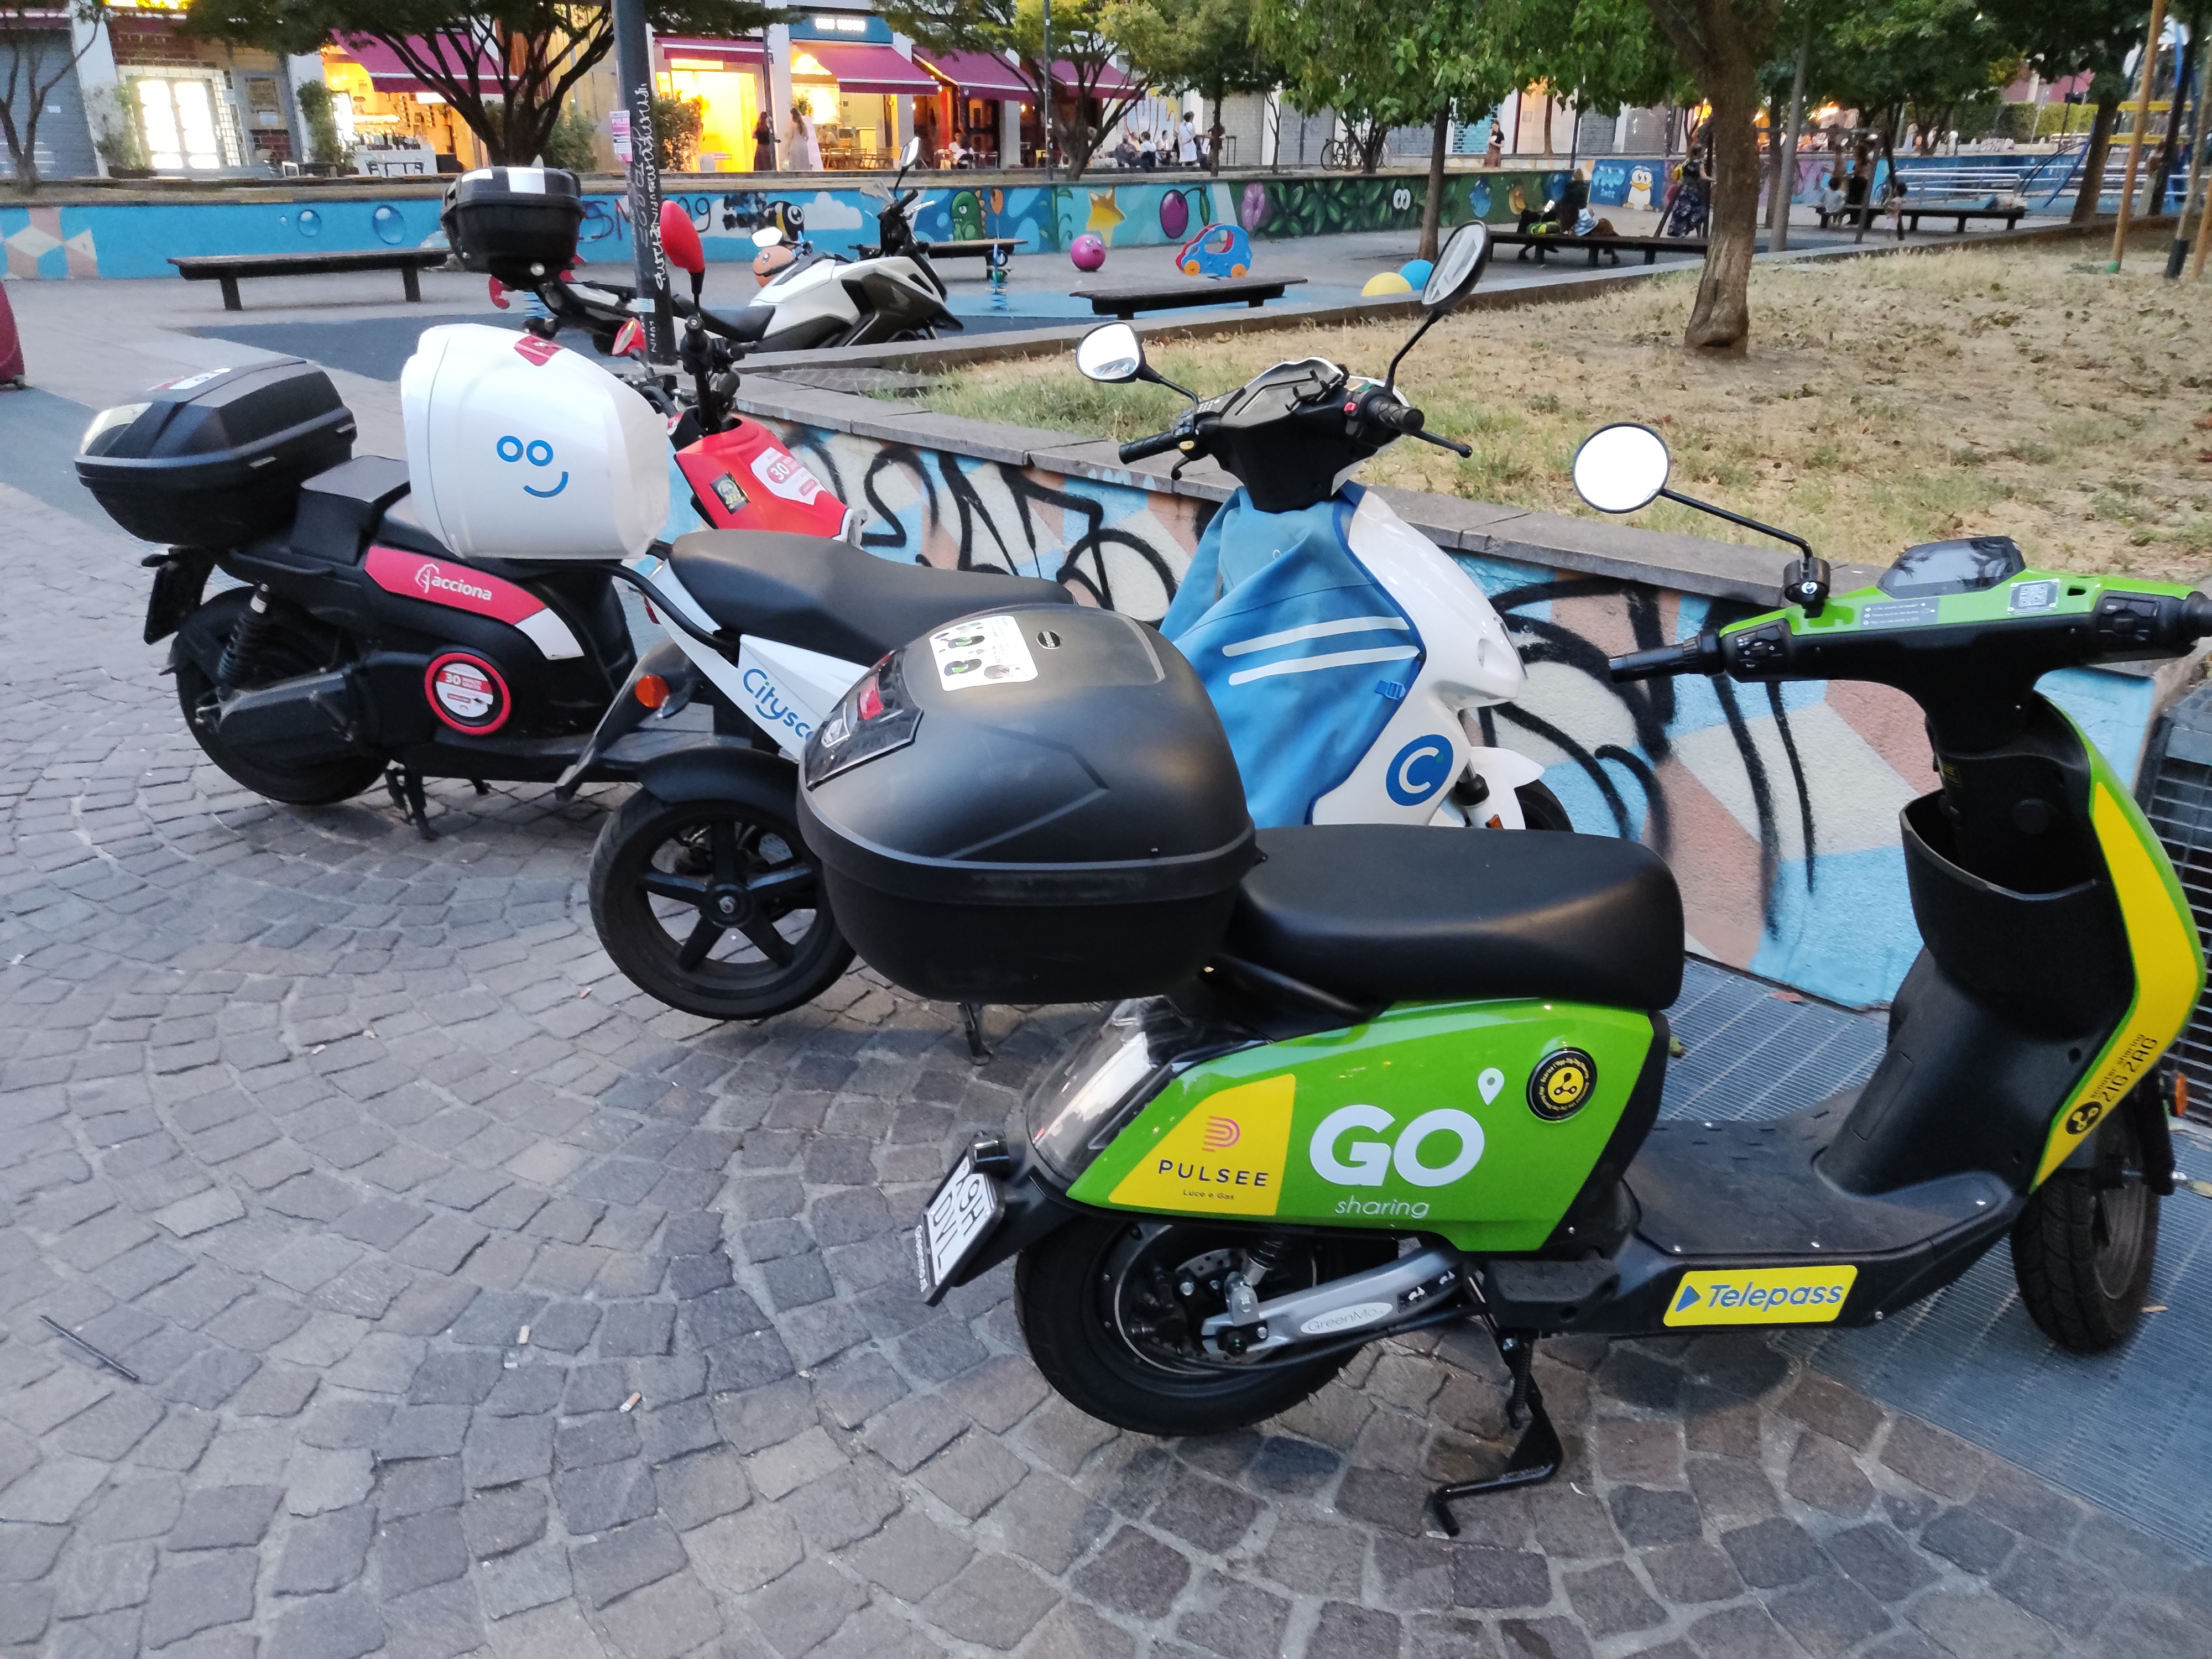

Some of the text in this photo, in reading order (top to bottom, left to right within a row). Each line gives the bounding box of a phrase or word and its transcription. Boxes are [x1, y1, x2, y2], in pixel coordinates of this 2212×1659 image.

[770, 462, 790, 481] 30
[431, 576, 492, 601] acciona
[445, 672, 462, 685] 30
[1309, 1104, 1485, 1187] GO
[1159, 1159, 1269, 1187] PULSEE
[1183, 1189, 1206, 1197] Luce
[1217, 1192, 1235, 1200] Gas
[1334, 1194, 1430, 1219] sharing
[1708, 1281, 1845, 1313] Telepass
